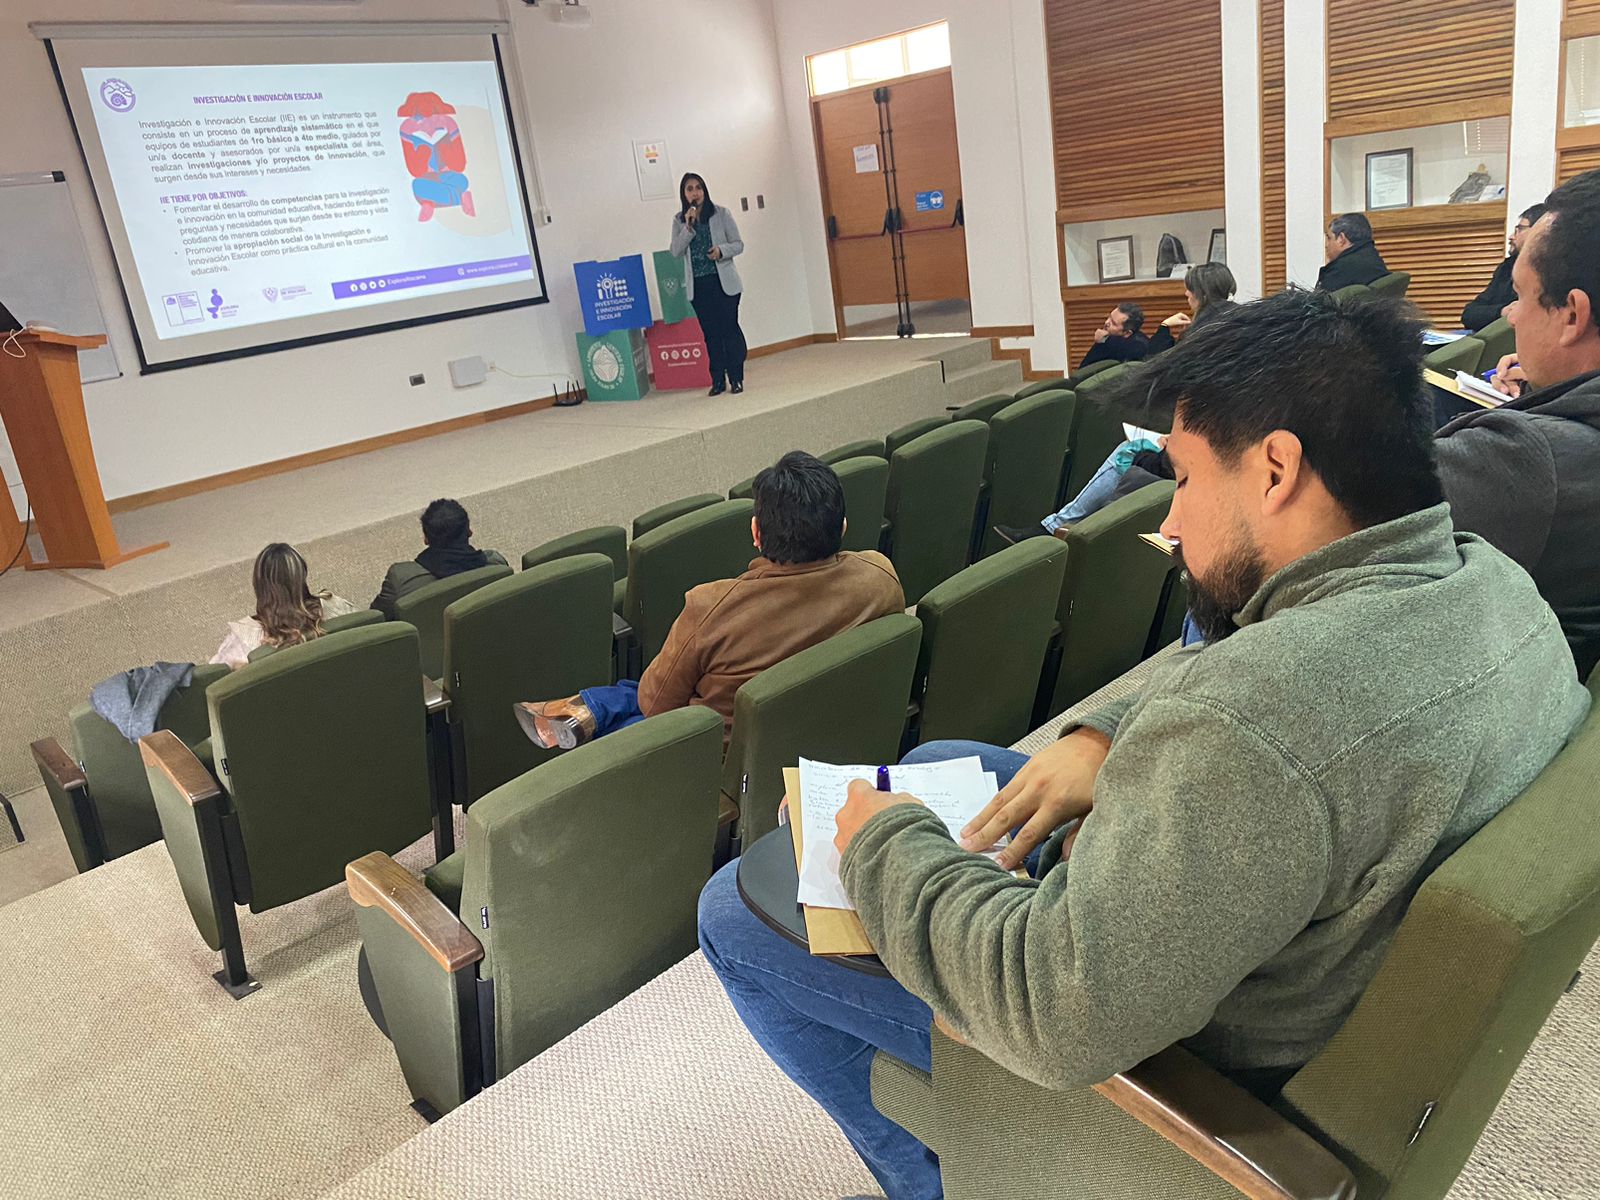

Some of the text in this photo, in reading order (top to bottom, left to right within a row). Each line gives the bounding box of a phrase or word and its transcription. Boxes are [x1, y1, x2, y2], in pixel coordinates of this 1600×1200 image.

[193, 94, 246, 104] INVESTIGACIÓN
[253, 92, 293, 101] INNOVACIÓN
[294, 92, 323, 100] ESCOLAR
[204, 117, 246, 125] Innovación
[248, 115, 276, 123] Escolar
[279, 113, 296, 123] (IIE)
[322, 111, 361, 120] instrumento
[364, 111, 377, 120] que
[142, 131, 175, 140] consiste
[207, 129, 237, 138] proceso
[240, 127, 251, 135] de
[254, 125, 298, 135] aprendizaje
[301, 122, 343, 131] sistemático
[366, 121, 379, 129] que
[145, 142, 177, 151] equipos
[179, 141, 190, 149] de
[192, 139, 236, 148] estudiantes
[266, 135, 292, 143] básico
[316, 132, 340, 141] medio,
[342, 131, 368, 140] guiados
[370, 131, 381, 139] por
[148, 153, 166, 161] un/a
[171, 151, 205, 160] docente
[210, 151, 215, 159] y
[221, 147, 263, 156] asesorados
[268, 147, 280, 155] por
[305, 142, 348, 152] especialista
[367, 140, 384, 148] área,
[151, 163, 183, 172] realizan
[187, 159, 252, 170] investigaciones
[256, 157, 268, 166] y/o
[273, 155, 310, 165] proyectos
[314, 153, 324, 161] de
[372, 150, 385, 158] que
[154, 174, 182, 183] surgen
[183, 172, 208, 181] desde
[209, 171, 223, 179] sus
[224, 169, 258, 177] intereses
[160, 190, 248, 204] IIE TIENE POR OBJETIVOS:
[173, 204, 211, 214] Fomentar
[213, 202, 220, 210] el
[222, 200, 258, 209] desarrollo
[260, 198, 270, 206] de
[271, 194, 322, 205] competencias
[324, 192, 340, 200] para
[348, 187, 390, 197] investigación
[179, 225, 219, 236] preguntas
[226, 219, 272, 230] necesidades
[274, 218, 288, 226] que
[288, 215, 311, 224] surjan
[312, 212, 332, 220] desde
[344, 209, 368, 217] entorno
[374, 206, 389, 214] vida
[183, 213, 226, 223] innovación
[247, 207, 287, 217] comunidad
[287, 204, 323, 213] educativa,
[323, 201, 355, 209] haciendo
[182, 236, 218, 245] cotidiana
[230, 231, 259, 240] manera
[185, 246, 223, 256] Promover
[224, 243, 231, 251] la
[233, 238, 279, 250] apropiación
[280, 234, 303, 244] social
[188, 255, 230, 266] Innovación
[231, 251, 259, 261] Escolar
[260, 249, 280, 257] como
[281, 245, 309, 255] práctica
[310, 241, 335, 250] cultural
[353, 235, 389, 245] comunidad
[191, 266, 230, 276] educativa.
